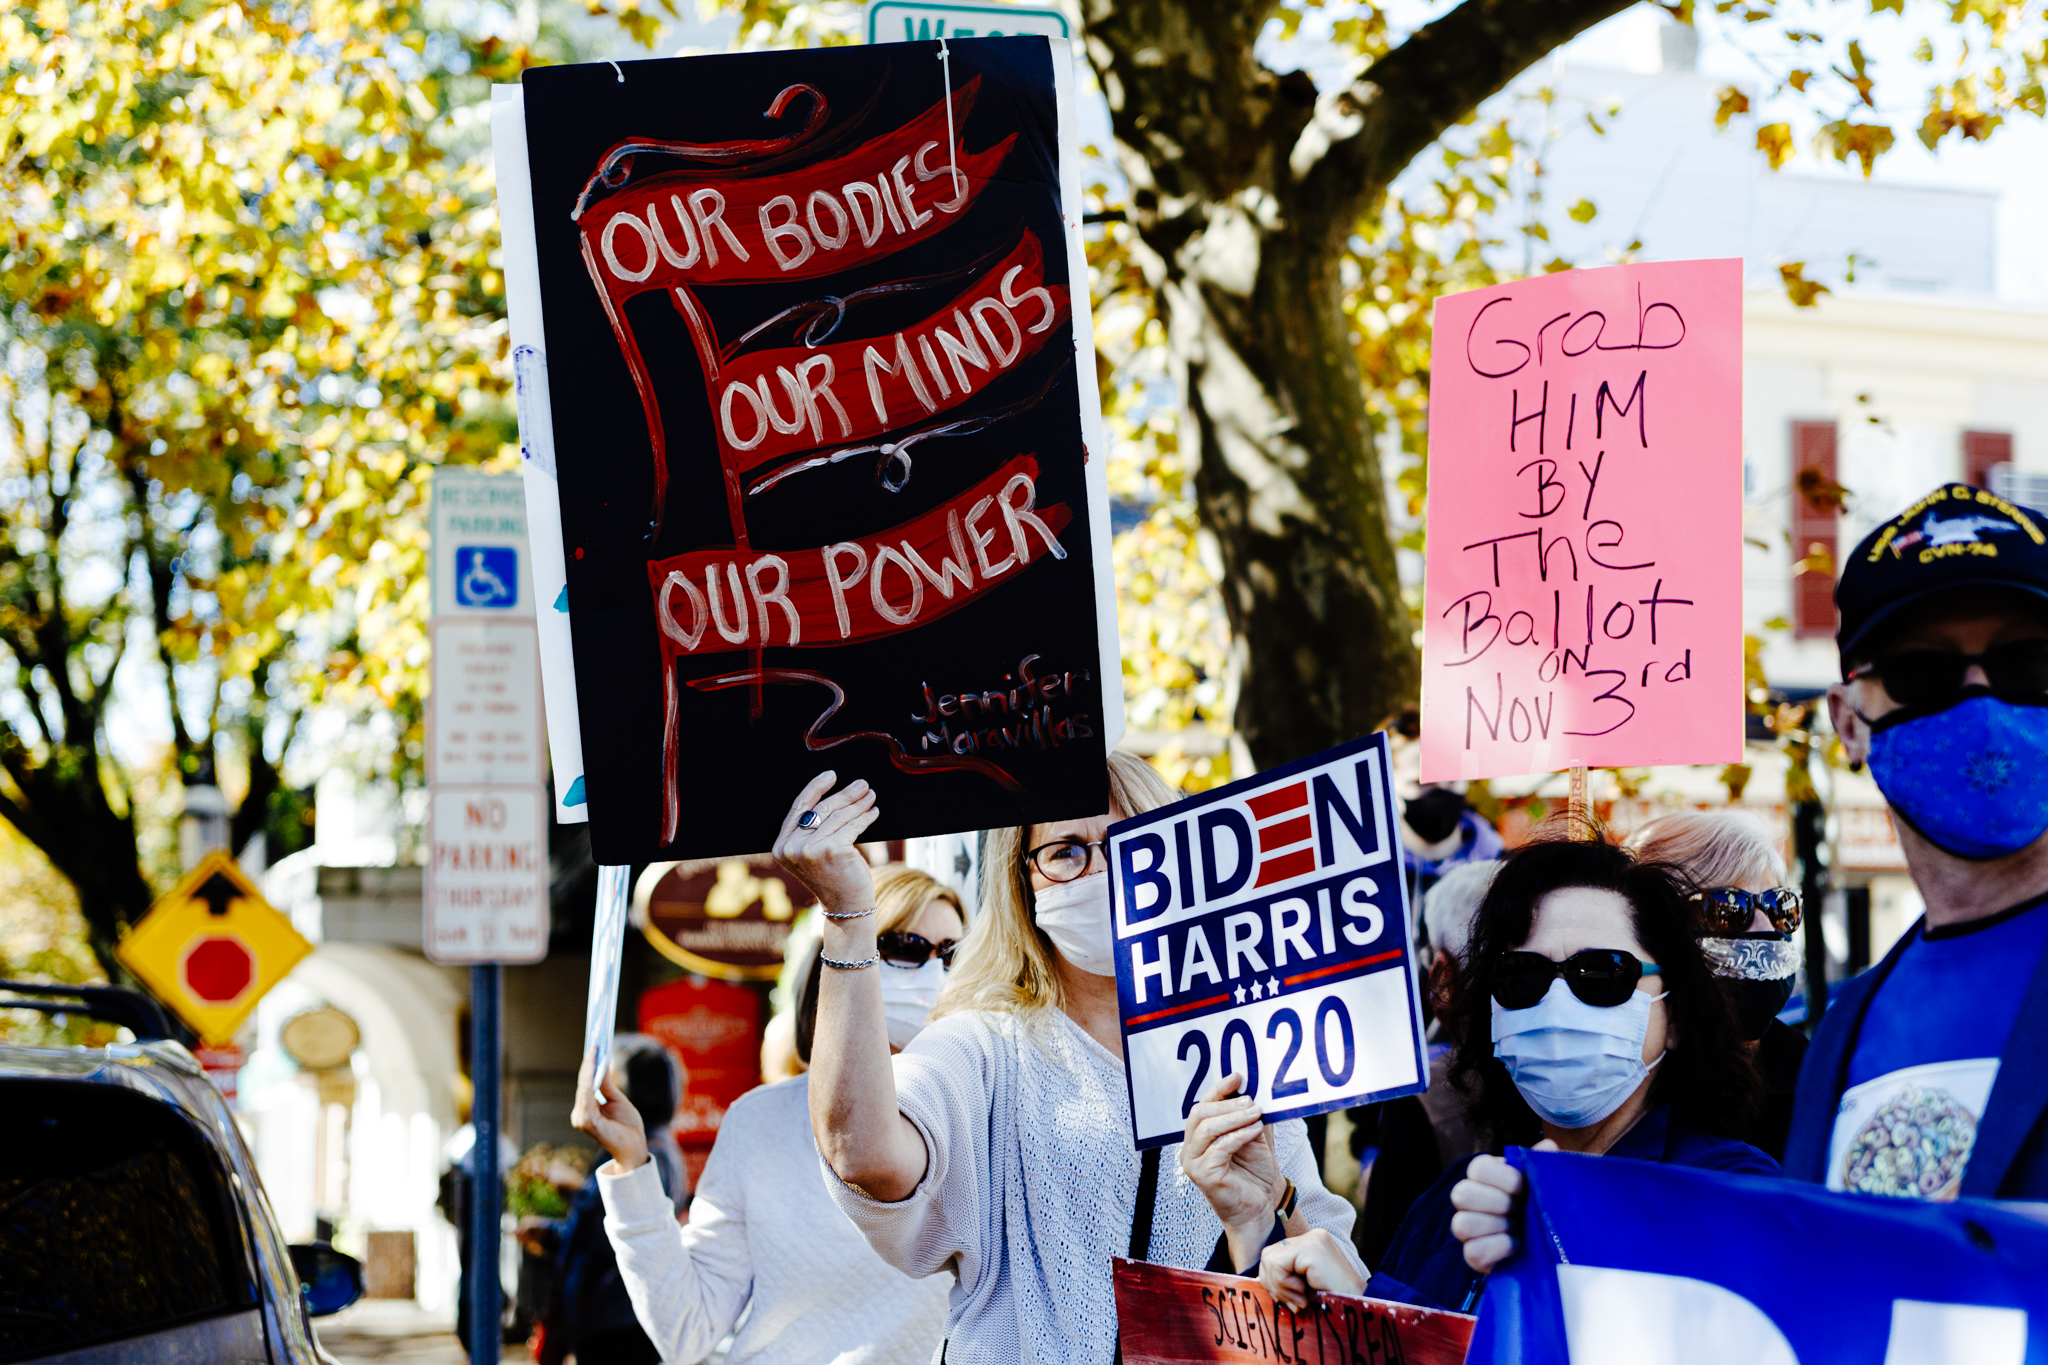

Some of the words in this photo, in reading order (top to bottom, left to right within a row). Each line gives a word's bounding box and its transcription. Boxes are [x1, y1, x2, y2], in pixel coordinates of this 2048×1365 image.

[602, 189, 749, 282] OUR
[759, 140, 968, 271] BODIES
[721, 353, 852, 450] OUR
[863, 264, 1055, 430] MINDS
[1467, 281, 1685, 379] Grab
[1510, 370, 1648, 455] HIM
[1516, 450, 1605, 520] BY
[658, 554, 799, 650] OUR
[823, 473, 1067, 638] POWER
[1462, 519, 1656, 588] The
[1443, 578, 1694, 667] Ballot
[911, 654, 1091, 723] Jennifer
[922, 704, 1094, 754] Maravillas
[1563, 647, 1692, 737] 3rd
[433, 845, 537, 872] PARKING
[465, 801, 507, 832] NO
[1118, 758, 1379, 928] BIDEN
[1130, 876, 1385, 1005] HARRIS
[1176, 995, 1355, 1120] 2020
[1202, 1286, 1308, 1365] SCIENCE
